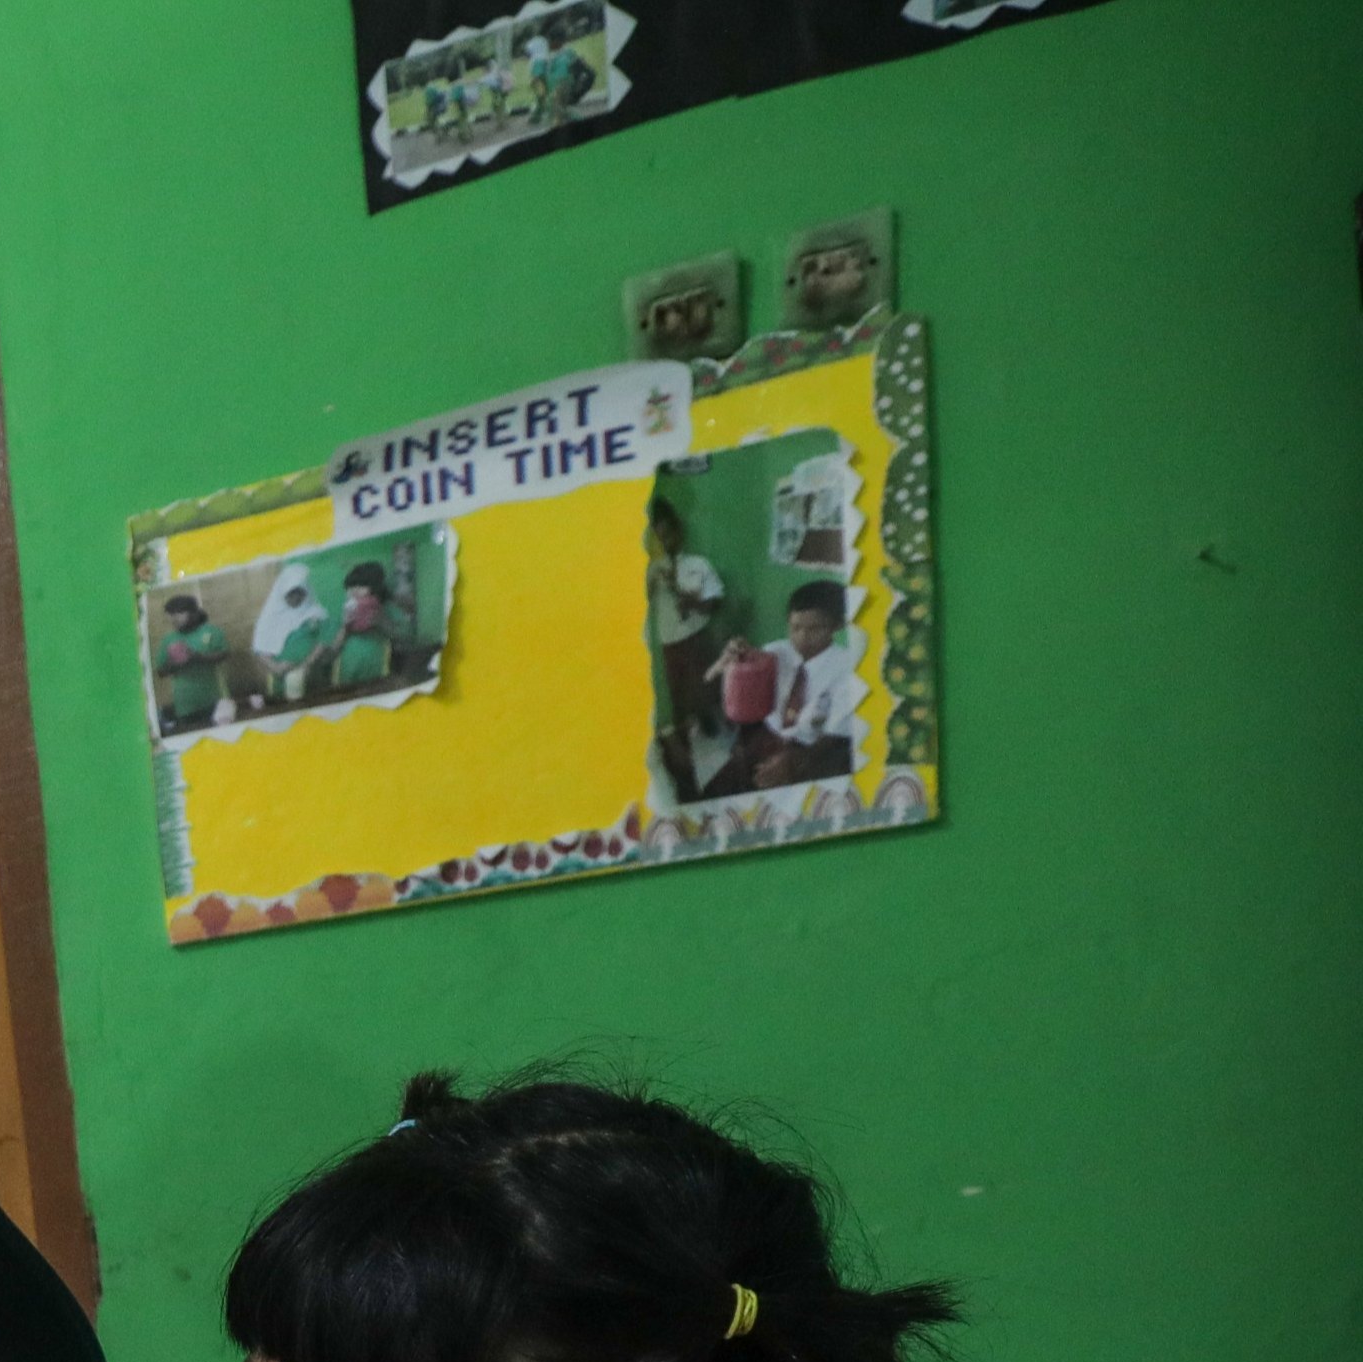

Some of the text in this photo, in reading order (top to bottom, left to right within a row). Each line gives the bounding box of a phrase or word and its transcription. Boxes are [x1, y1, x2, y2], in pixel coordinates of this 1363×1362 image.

[351, 423, 636, 519] COIN TIME
[383, 385, 600, 473] INSERT
